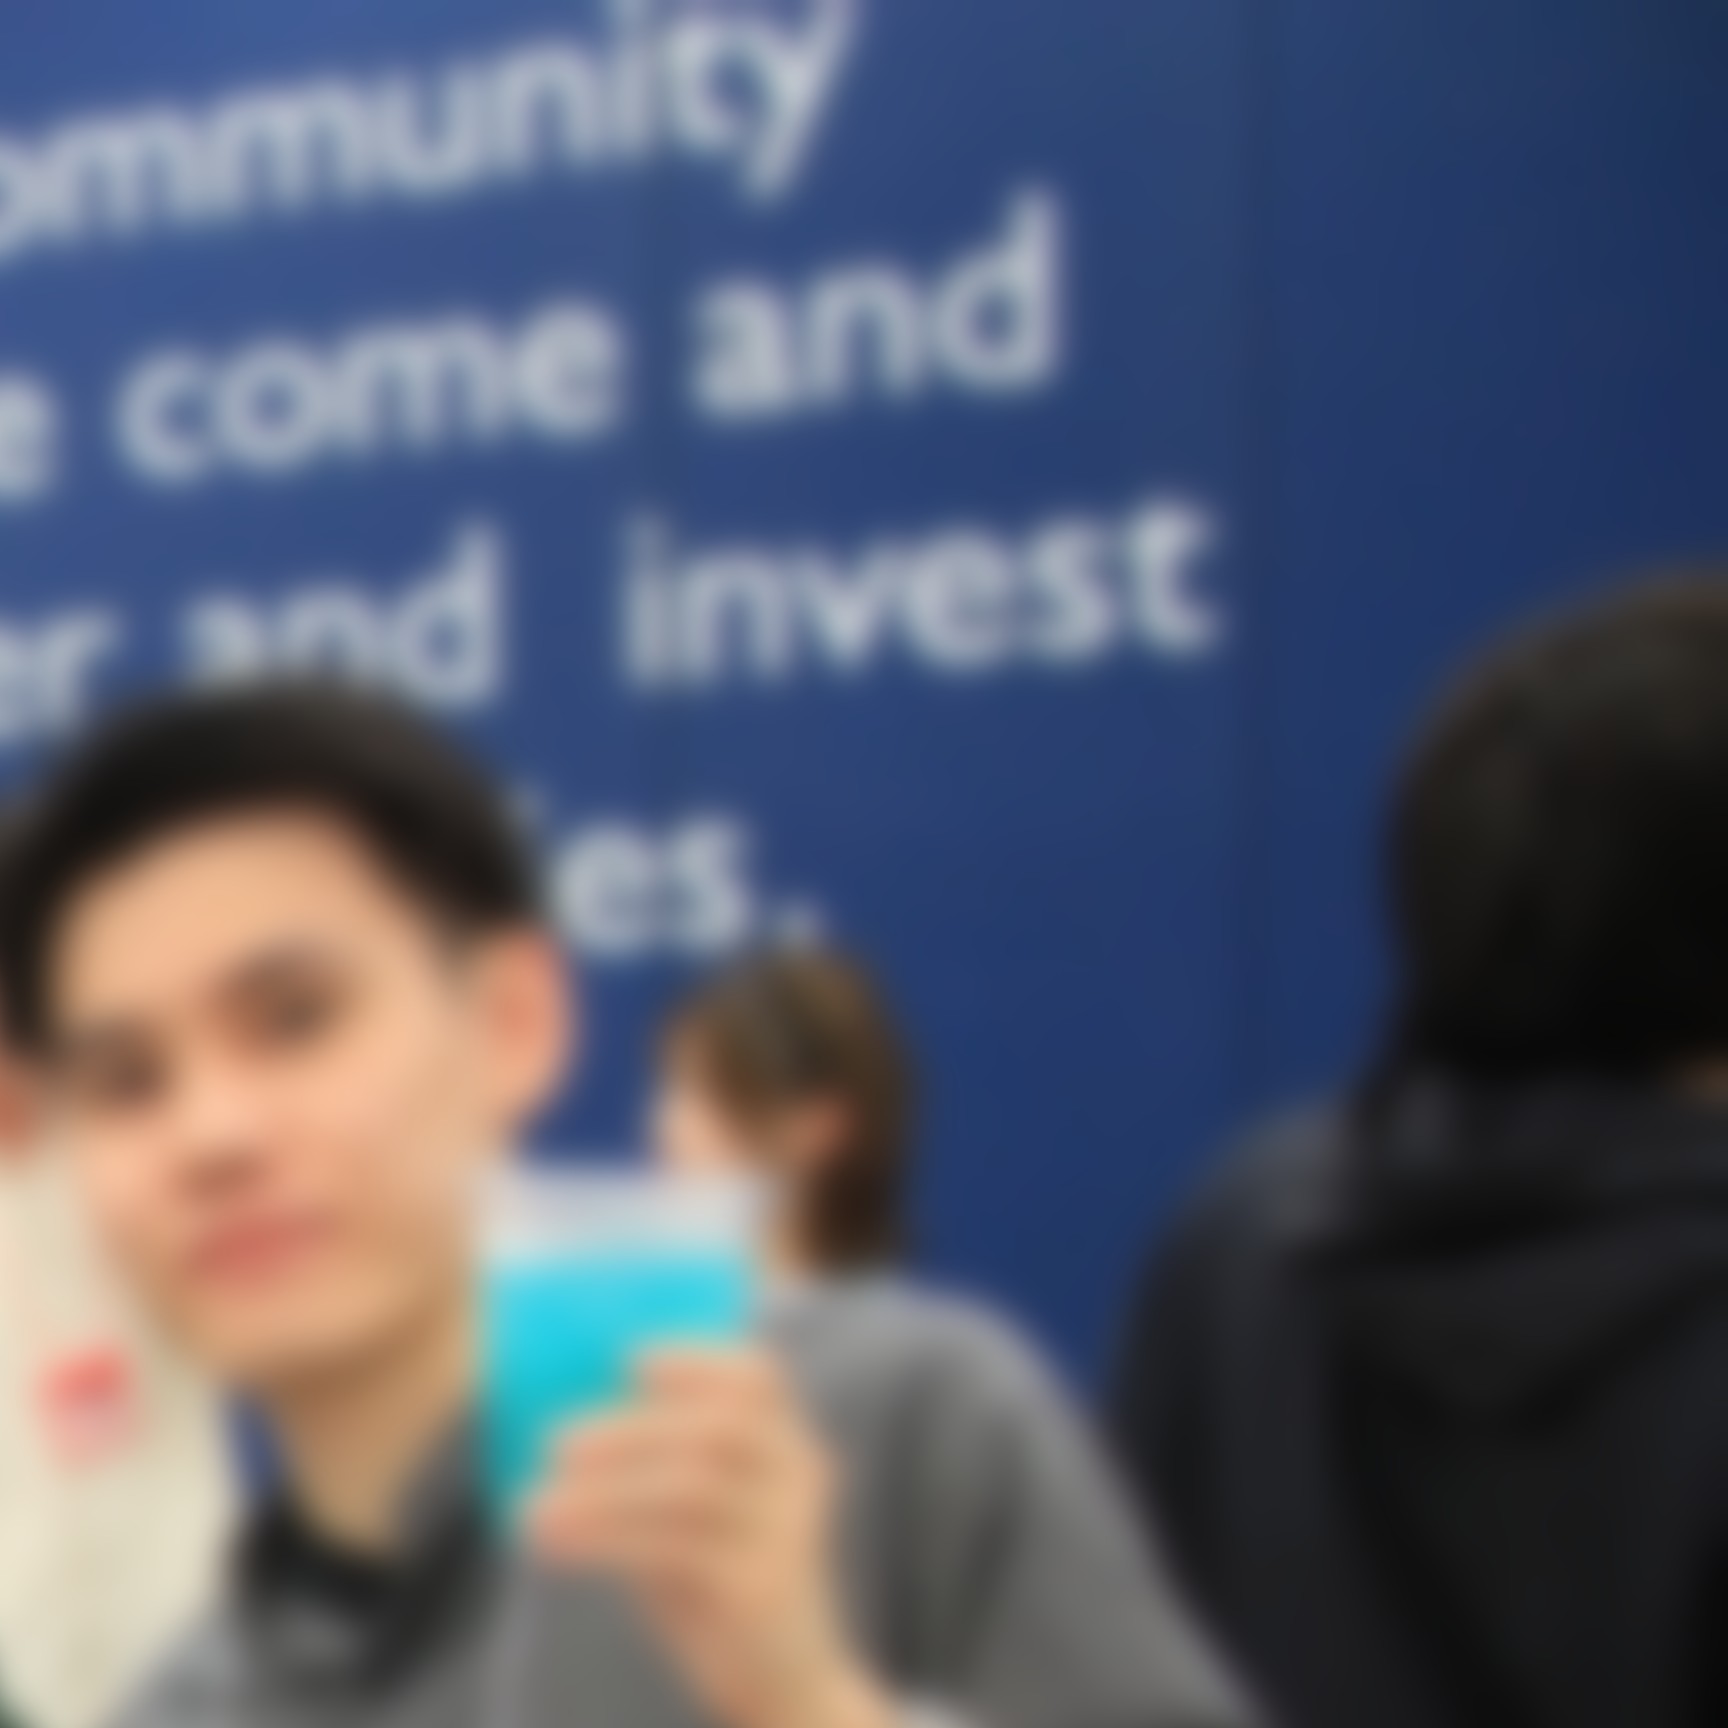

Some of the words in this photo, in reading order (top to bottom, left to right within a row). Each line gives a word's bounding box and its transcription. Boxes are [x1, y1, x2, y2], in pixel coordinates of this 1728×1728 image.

[119, 303, 619, 476] come
[692, 190, 1056, 413] and
[184, 524, 499, 708] and
[627, 510, 1216, 684] invest
